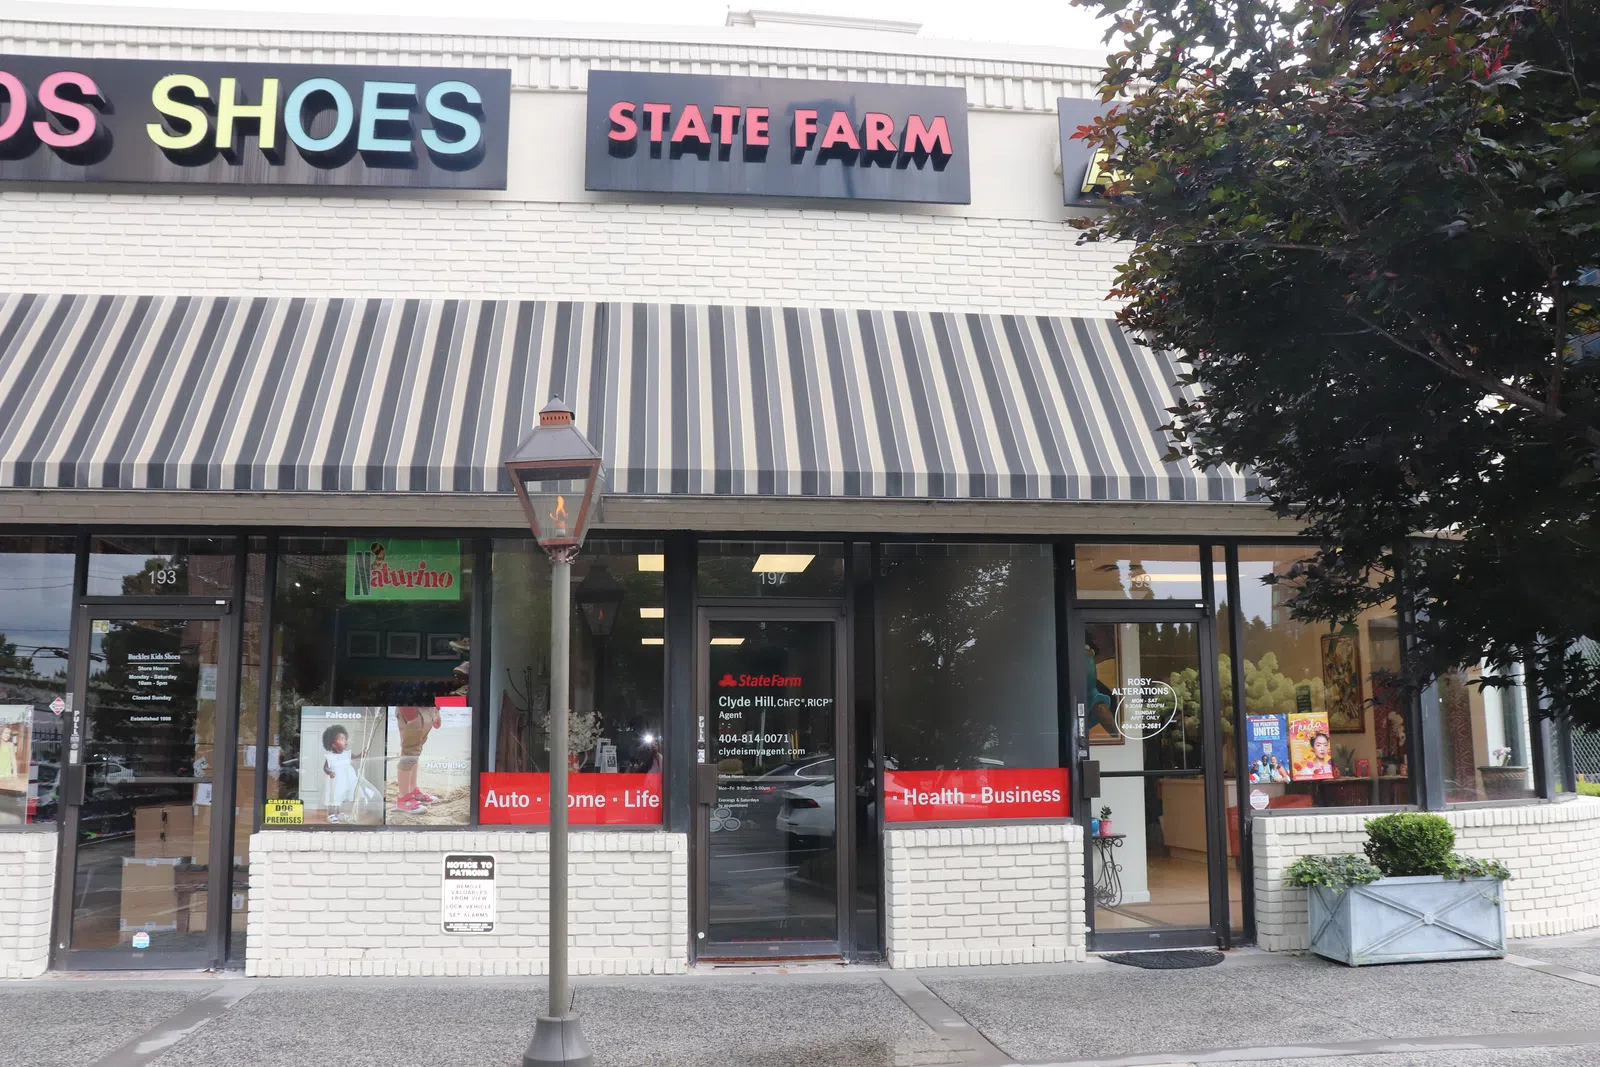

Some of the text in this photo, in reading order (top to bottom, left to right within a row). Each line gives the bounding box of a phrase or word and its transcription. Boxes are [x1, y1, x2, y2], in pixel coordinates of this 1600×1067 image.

[146, 74, 482, 155] SHOES
[607, 101, 953, 155] STATE FARM
[148, 570, 176, 585] 193
[353, 550, 453, 596] Naturino
[738, 674, 802, 687] State Farm
[1127, 678, 1152, 686] ROSY
[1111, 687, 1169, 696] ALTERATIONS
[718, 696, 751, 709] Clyde
[325, 711, 362, 719] Falcotto
[718, 711, 742, 720] Agent
[1253, 726, 1280, 737] UNITES
[718, 734, 789, 743] 404-814-0071
[718, 747, 806, 757] clydeismyagent.com
[426, 761, 467, 769] NATURINO
[484, 789, 660, 808] Auto ome Life
[903, 785, 1061, 806] Health Business
[446, 861, 493, 869] NOTICE TO
[449, 869, 489, 877] PATRONS
